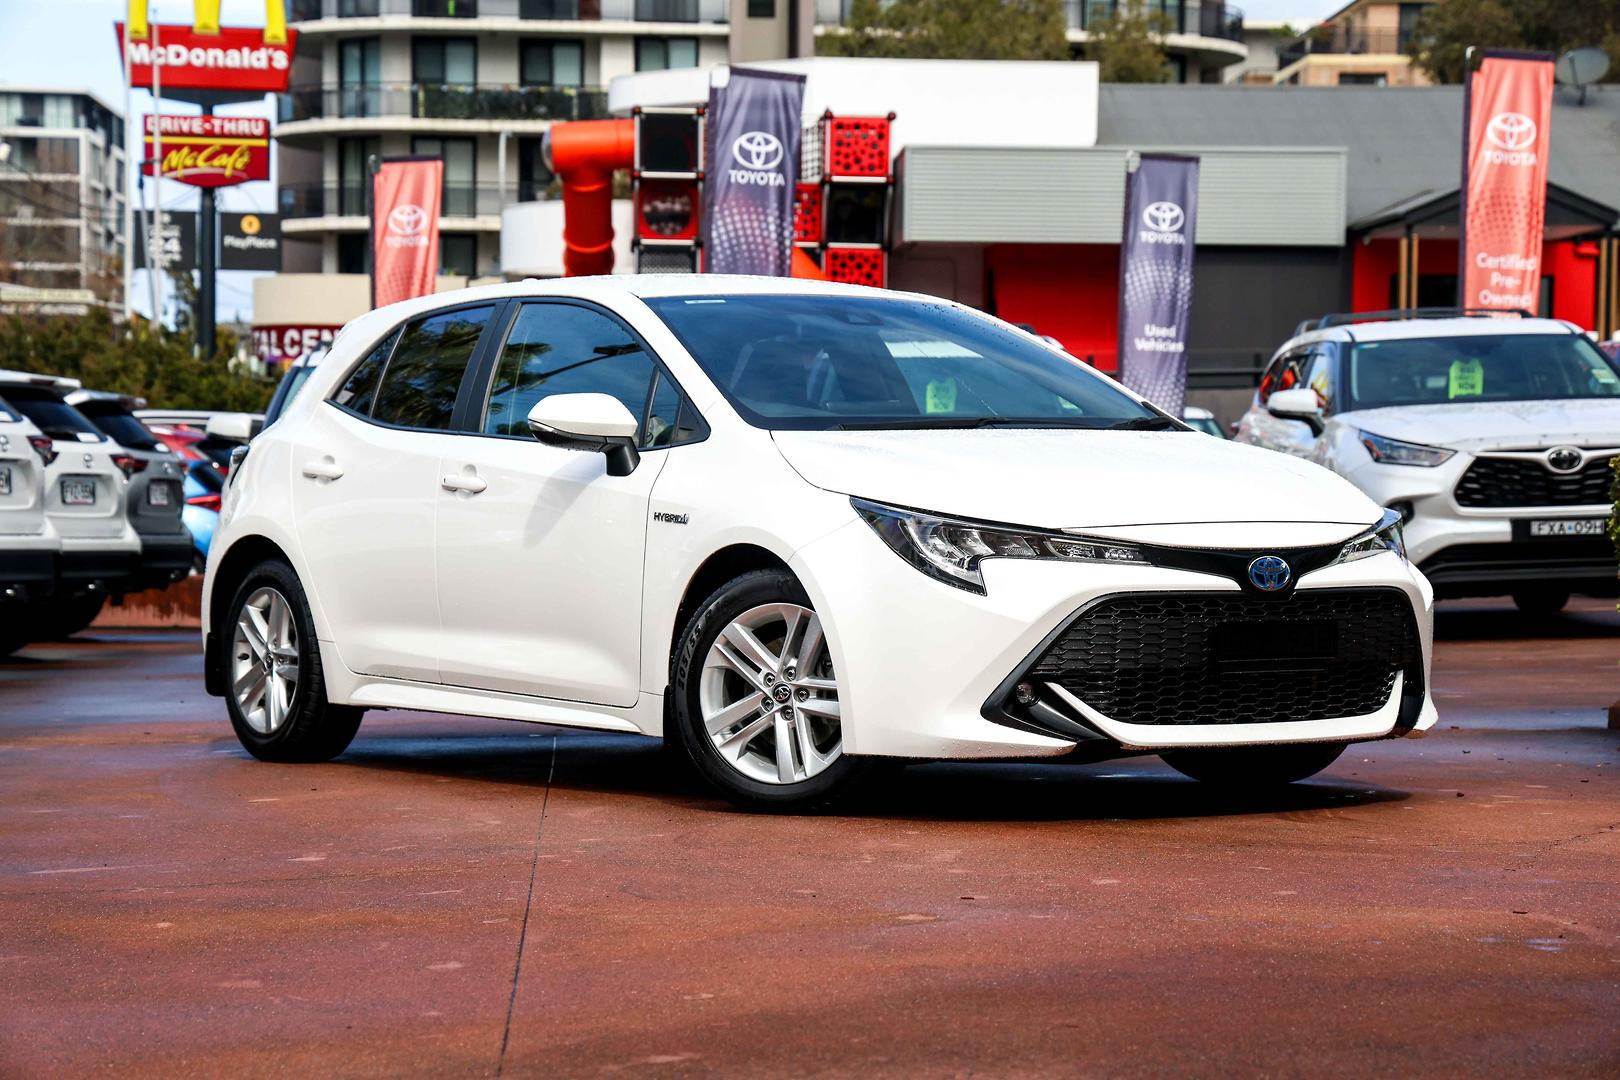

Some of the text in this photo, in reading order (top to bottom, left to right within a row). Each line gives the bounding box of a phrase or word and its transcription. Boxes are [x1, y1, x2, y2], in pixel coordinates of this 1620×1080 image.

[128, 43, 289, 70] McDonald's
[1482, 150, 1537, 166] TOYOTA
[728, 169, 786, 187] TOYOTA
[1140, 230, 1186, 244] TOYOTA
[1476, 252, 1537, 270] Certified
[1490, 271, 1521, 288] Pre-
[1479, 289, 1533, 308] Owned
[1144, 324, 1177, 338] Used
[1134, 337, 1185, 352] Vehicles
